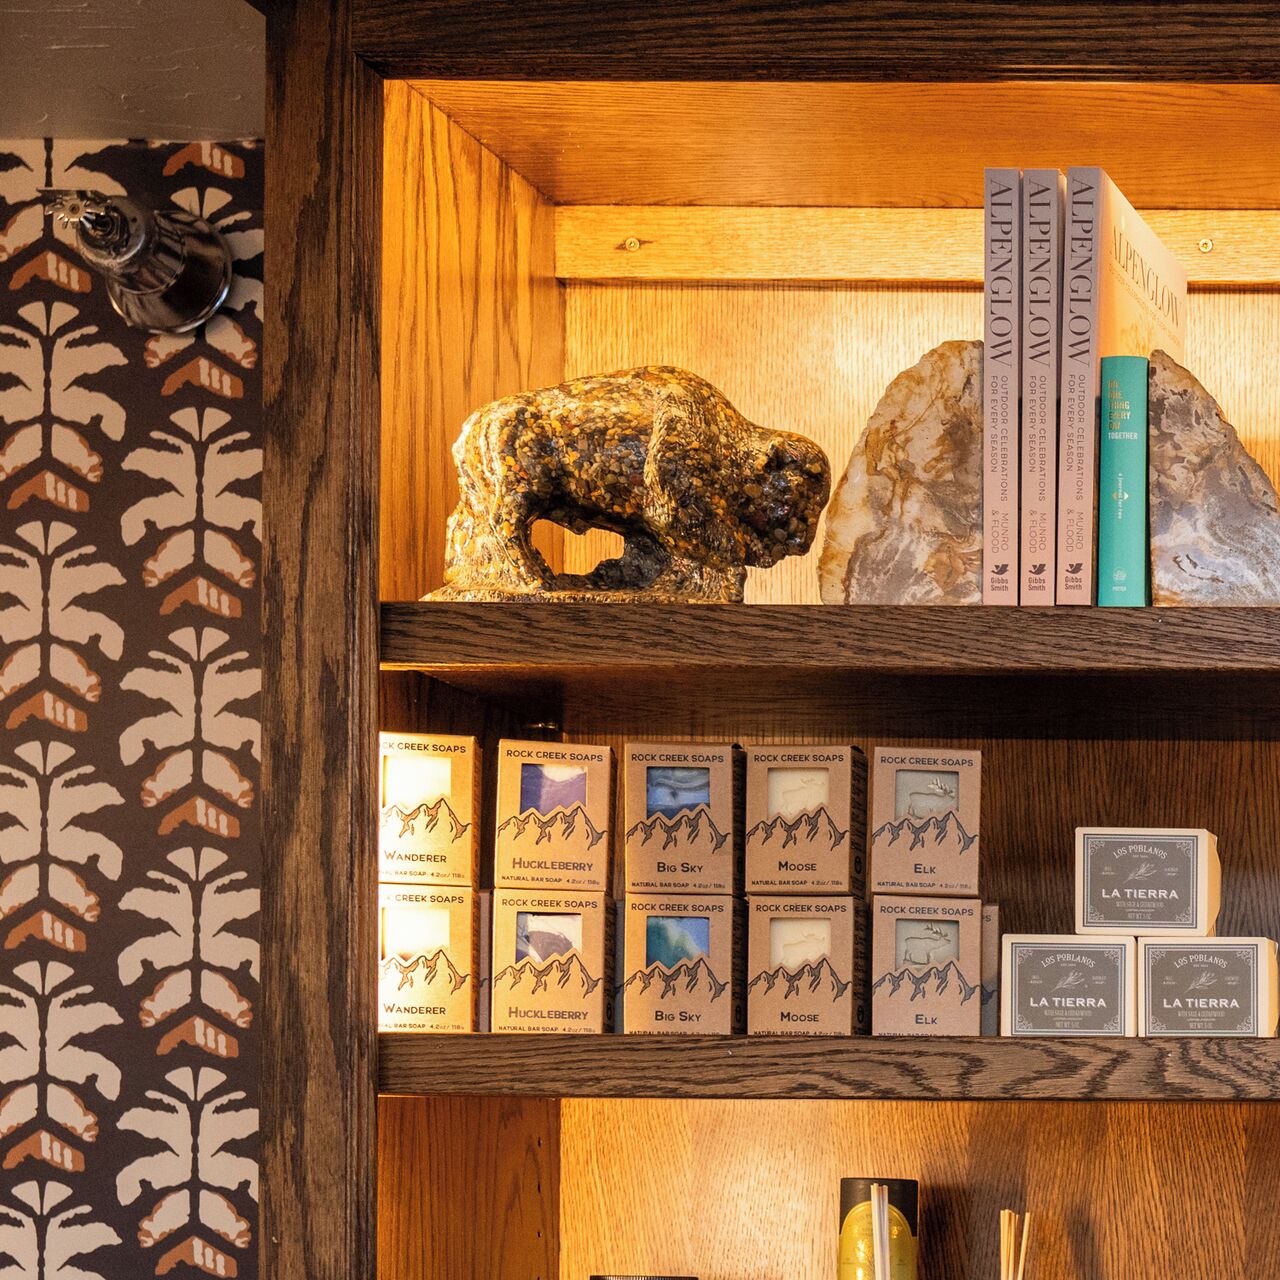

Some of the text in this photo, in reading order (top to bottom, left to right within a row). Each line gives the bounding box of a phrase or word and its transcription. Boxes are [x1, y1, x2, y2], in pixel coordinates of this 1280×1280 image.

[989, 178, 1014, 368] ALPENGLOW
[1028, 178, 1051, 368] ALPENGLOW
[1068, 178, 1096, 367] ALPENGLOW
[1110, 226, 1181, 327] ALPENGLOW
[990, 376, 998, 472] FOR EVERY SEASON
[1038, 376, 1047, 502] OUTDOOR CELEBRATIONS
[1108, 432, 1138, 440] TOGETHER
[506, 749, 603, 762] ROCK CREEK SOAPS
[753, 754, 844, 762] ROCK CREEK SOAPS
[880, 756, 974, 767] ROCK CREEK SOAPS
[1114, 844, 1168, 860] LOS POBLANOS
[1102, 888, 1179, 899] LA TIERRA
[1030, 997, 1106, 1008] LA TIERRA
[1163, 998, 1240, 1008] LA TIERRA
